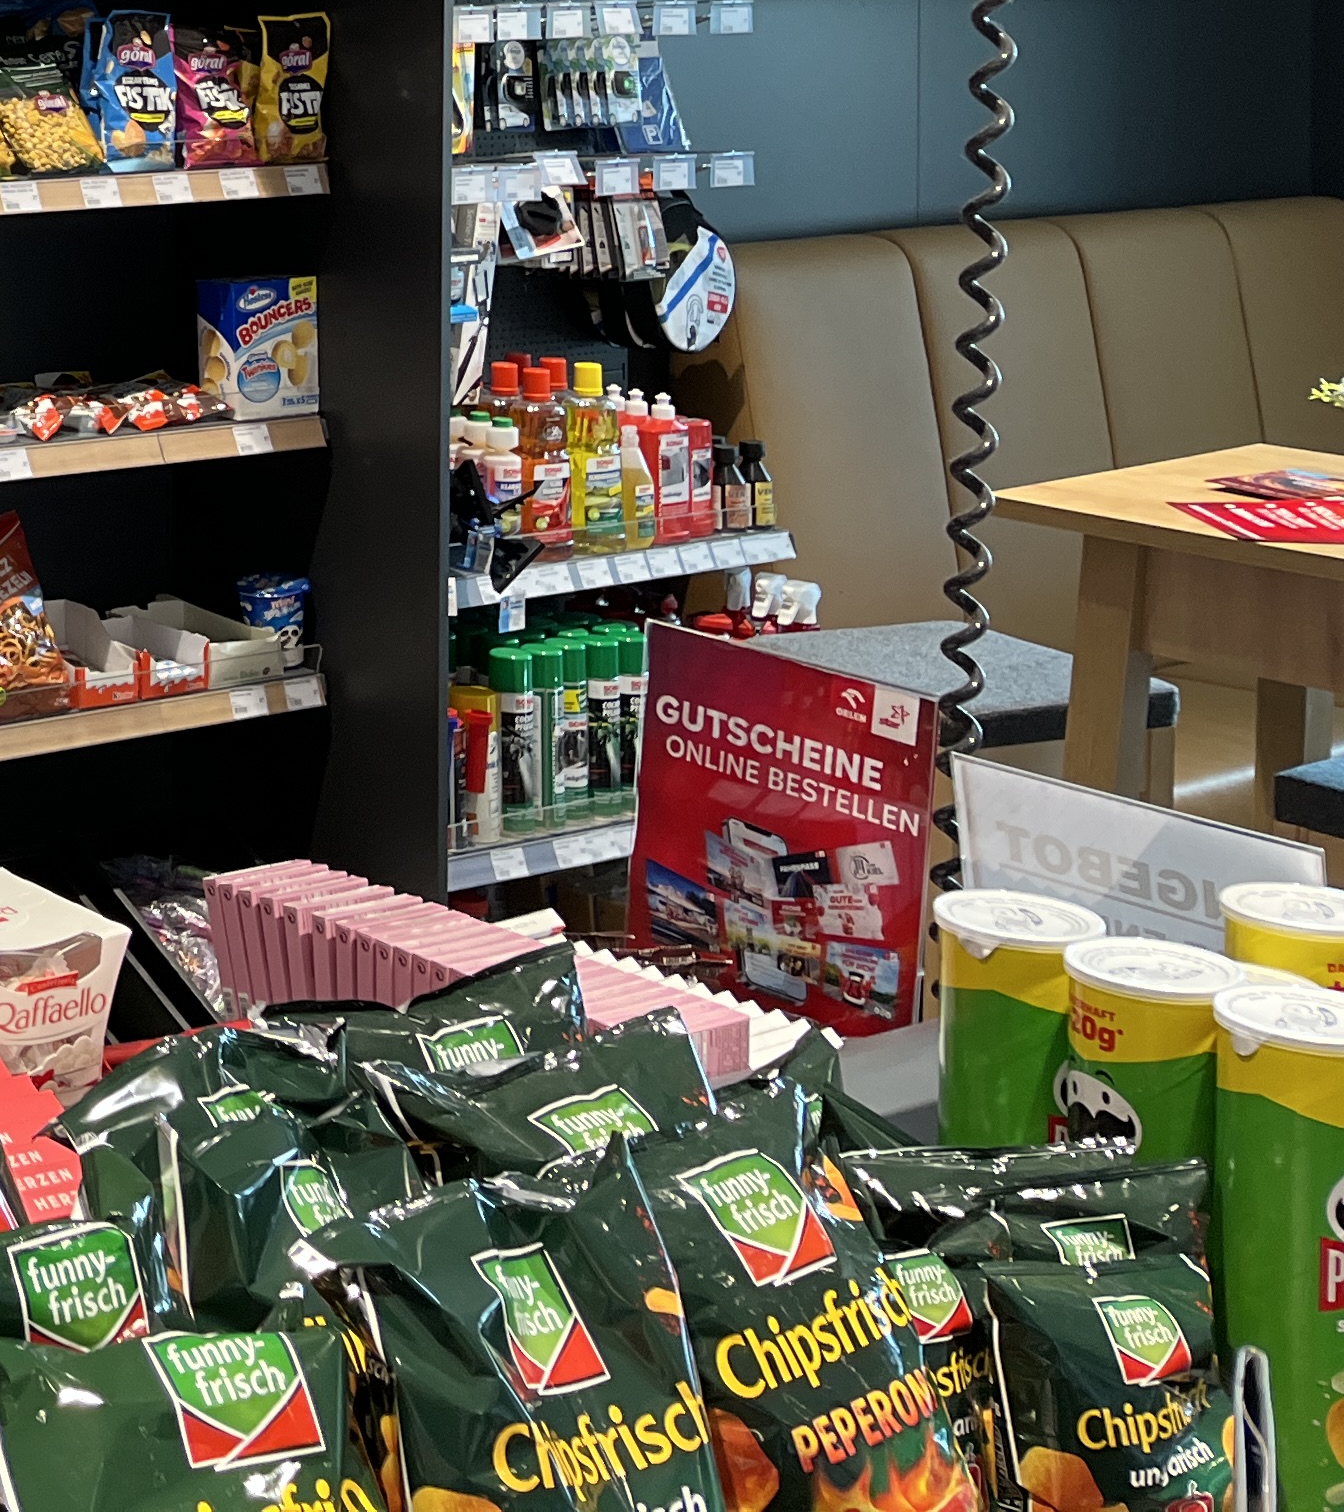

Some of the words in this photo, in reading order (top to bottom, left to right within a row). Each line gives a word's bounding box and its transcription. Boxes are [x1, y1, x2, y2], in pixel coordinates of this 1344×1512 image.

[190, 55, 224, 72] göral
[282, 52, 310, 68] göral
[38, 95, 66, 110] göral
[115, 86, 171, 110] FISTIK
[282, 91, 322, 116] FISTIK
[236, 298, 312, 347] BOUNCERS
[835, 706, 867, 723] ORLEN
[655, 694, 884, 790] GUTSCHEINE
[665, 734, 759, 784] ONLINE
[768, 768, 920, 836] BESTELLEN
[831, 897, 853, 906] GUTE
[705, 1170, 771, 1209] funny-
[730, 1186, 798, 1237] frisch
[28, 1251, 116, 1293] funny-
[897, 1264, 946, 1289] funny-
[48, 1278, 127, 1328] frisch
[909, 1279, 959, 1307] frisch
[1108, 1303, 1159, 1332] funny-
[1125, 1323, 1172, 1350] frisch
[167, 1337, 266, 1373] funny-
[196, 1365, 286, 1406] frisch
[1130, 1443, 1214, 1489] ungarisch
